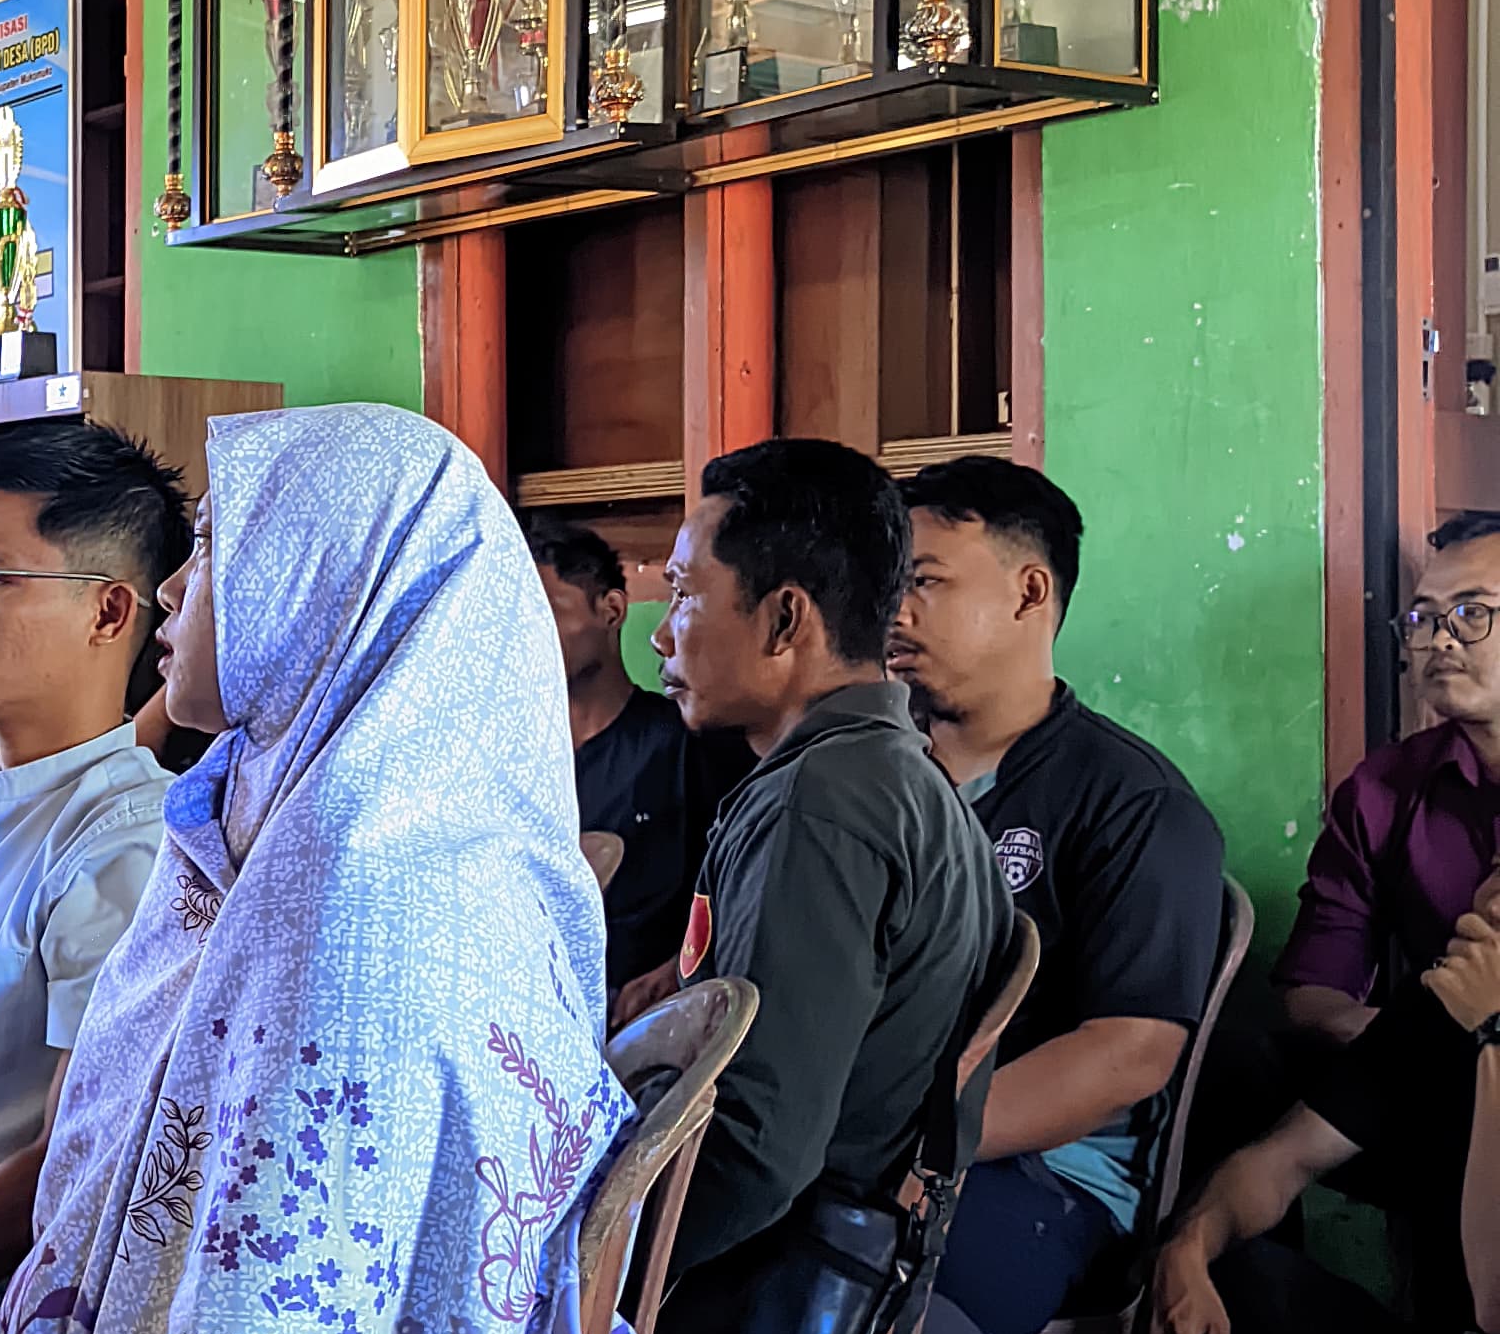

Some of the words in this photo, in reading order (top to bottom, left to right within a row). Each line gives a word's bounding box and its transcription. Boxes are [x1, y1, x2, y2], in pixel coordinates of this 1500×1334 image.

[3, 40, 29, 70] DESA
[30, 27, 59, 62] (BPD)
[995, 845, 1042, 862] FUTSAL
